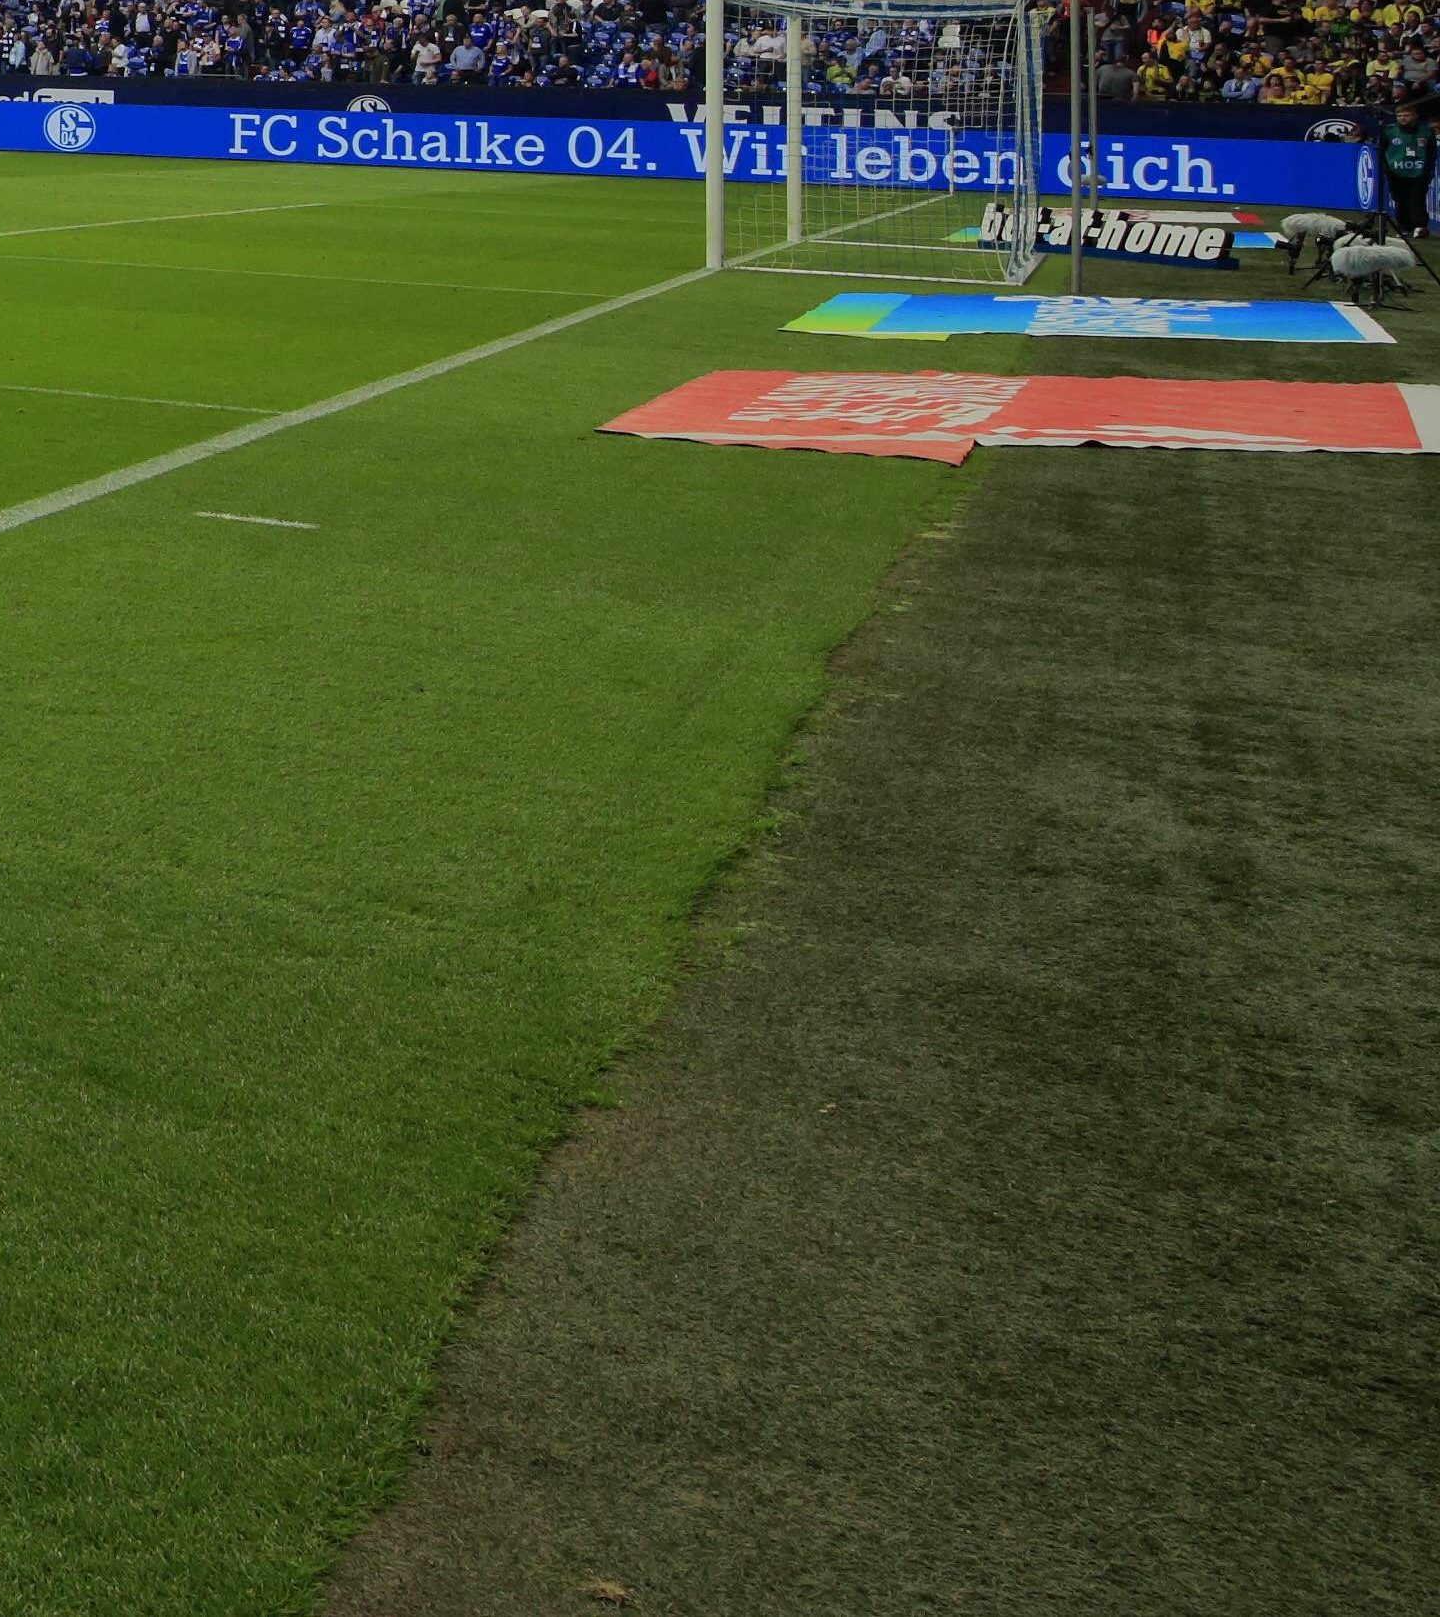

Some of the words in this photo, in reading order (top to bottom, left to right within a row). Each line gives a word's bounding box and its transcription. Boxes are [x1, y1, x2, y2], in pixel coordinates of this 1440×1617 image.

[229, 113, 298, 157] FC
[317, 115, 546, 167] Schalke
[567, 125, 657, 171] 04.
[680, 127, 811, 179] Wir
[826, 133, 1024, 187] leben
[1057, 147, 1236, 195] dich.
[982, 202, 1227, 261] bet-at-home
